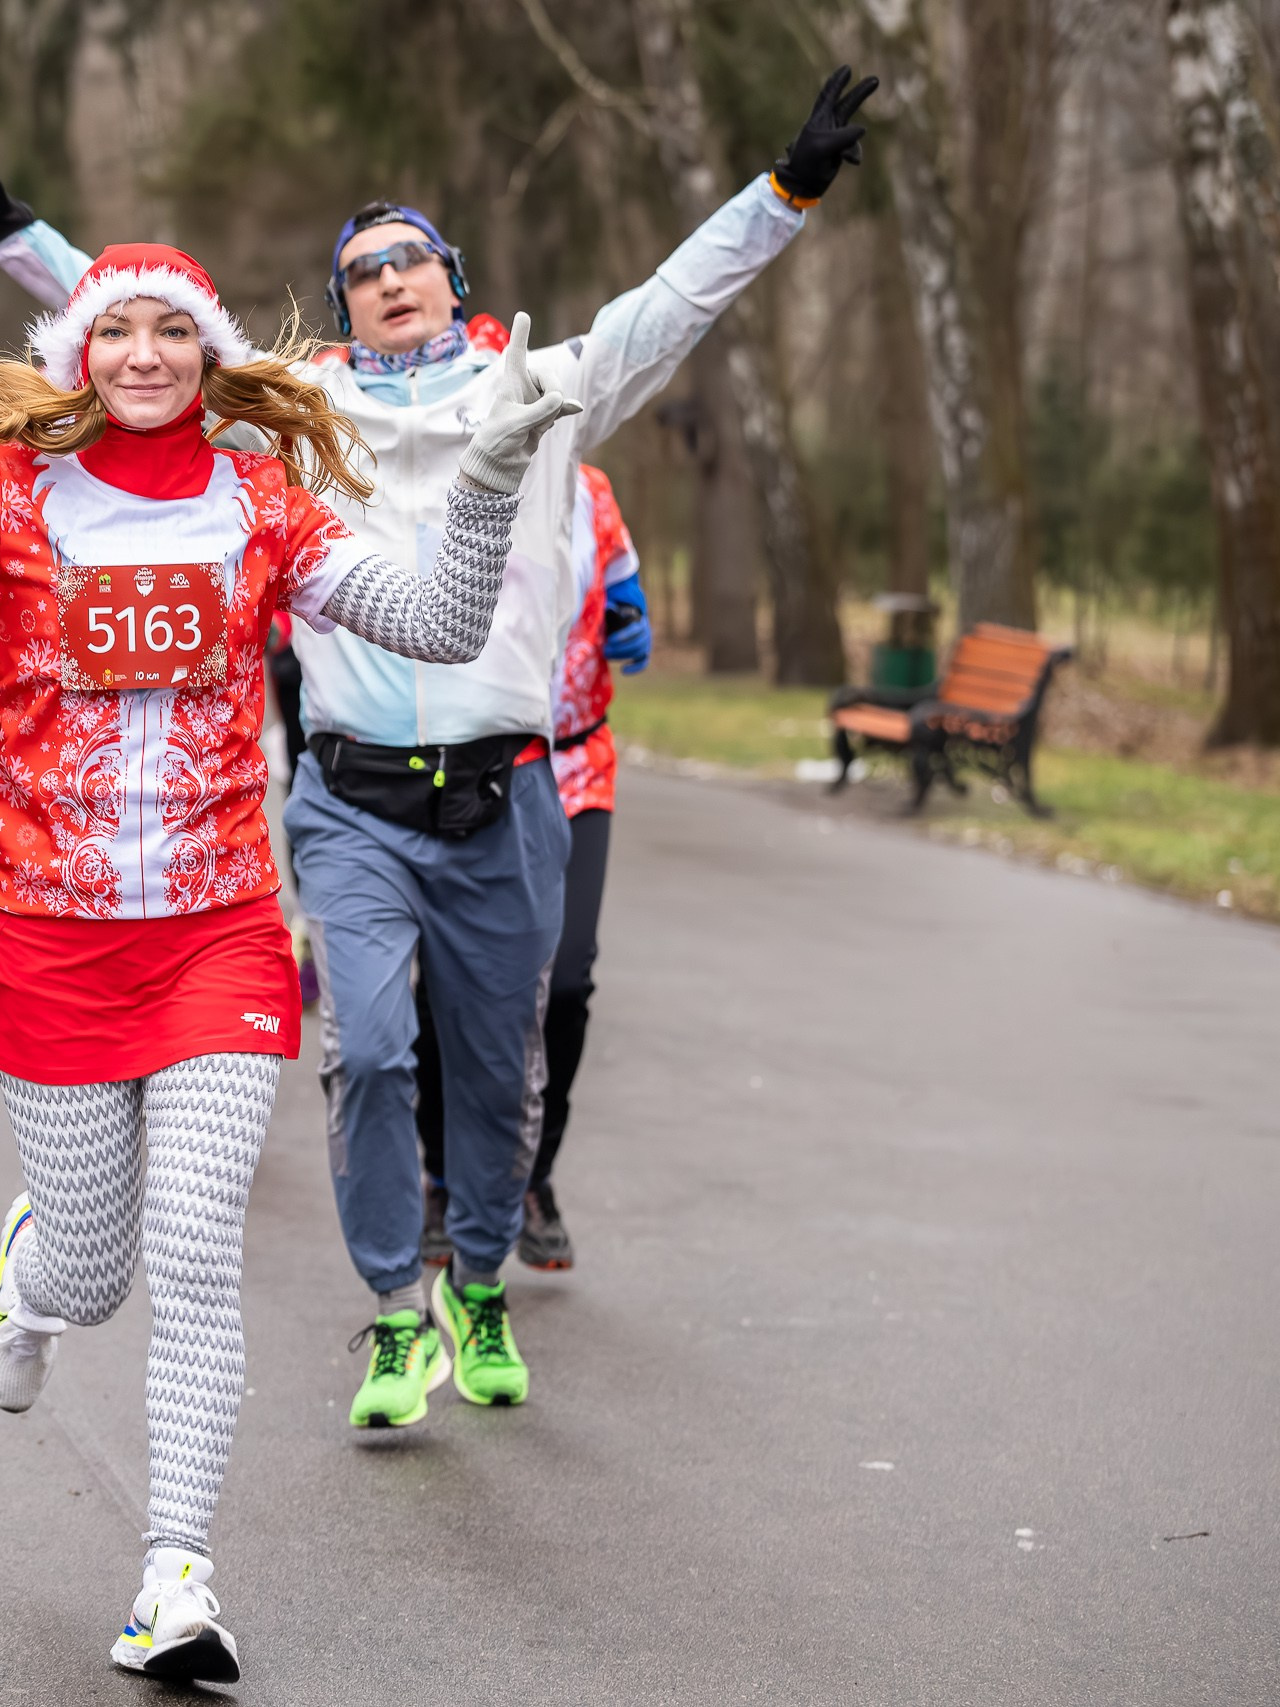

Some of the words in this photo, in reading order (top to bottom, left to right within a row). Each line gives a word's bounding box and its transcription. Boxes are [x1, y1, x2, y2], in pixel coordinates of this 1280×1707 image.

[87, 604, 202, 654] 5163
[135, 671, 145, 681] 10
[245, 1012, 280, 1034] RAY
